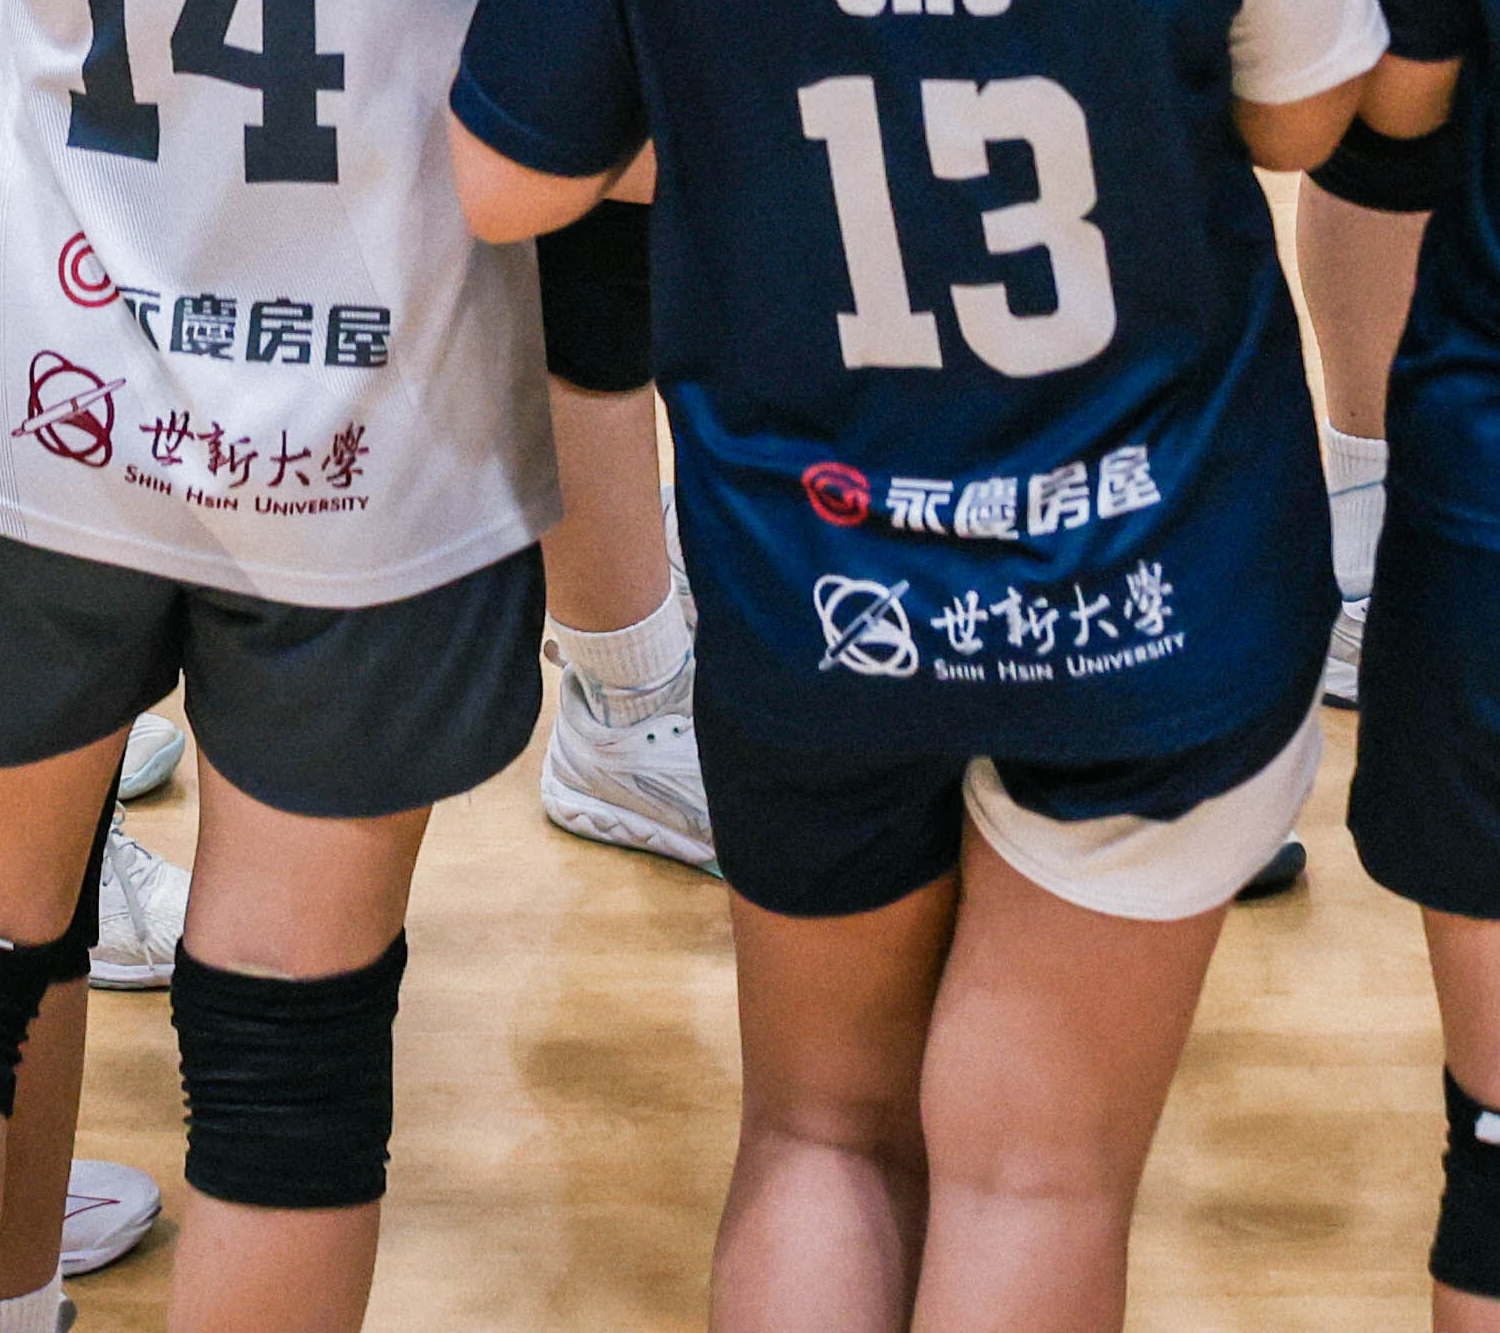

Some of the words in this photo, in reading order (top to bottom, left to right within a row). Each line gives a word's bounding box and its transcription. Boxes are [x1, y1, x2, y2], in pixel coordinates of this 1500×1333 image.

[797, 75, 1117, 379] 13
[139, 409, 370, 489] 世新大學
[885, 445, 1162, 540] 永慶房屋
[930, 559, 1174, 655] 世新大學
